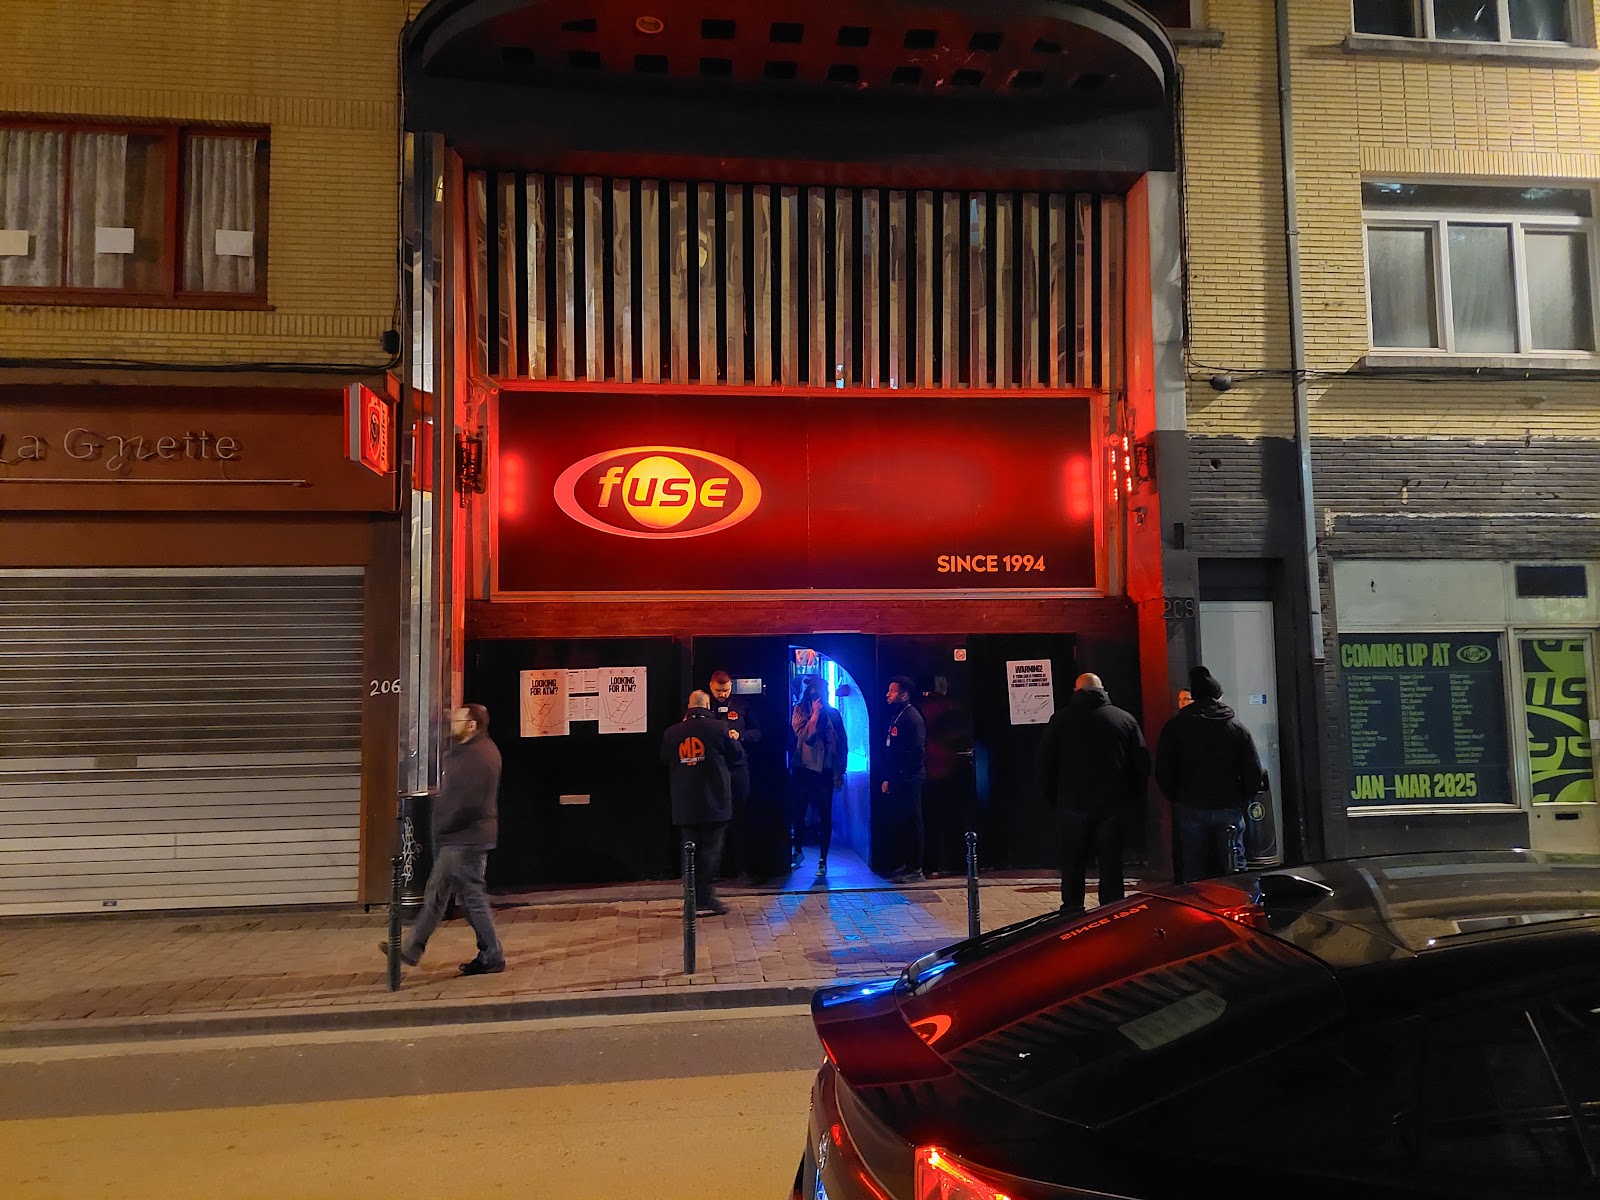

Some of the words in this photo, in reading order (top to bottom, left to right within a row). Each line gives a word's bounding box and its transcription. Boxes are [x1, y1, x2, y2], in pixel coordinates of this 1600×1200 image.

[0, 434, 40, 465] a
[937, 555, 998, 573] SINCE
[1003, 554, 1045, 572] 1994
[1341, 643, 1404, 668] COMING
[1406, 643, 1428, 667] UP
[1432, 643, 1450, 667] AT
[370, 679, 400, 696] 206
[531, 679, 557, 689] LOOKING
[608, 684, 619, 693] FOR
[621, 683, 637, 693] ATM?
[610, 676, 635, 685] LOOKING
[530, 687, 542, 696] FOR
[542, 686, 559, 696] ATM?
[1434, 772, 1478, 798] 2025
